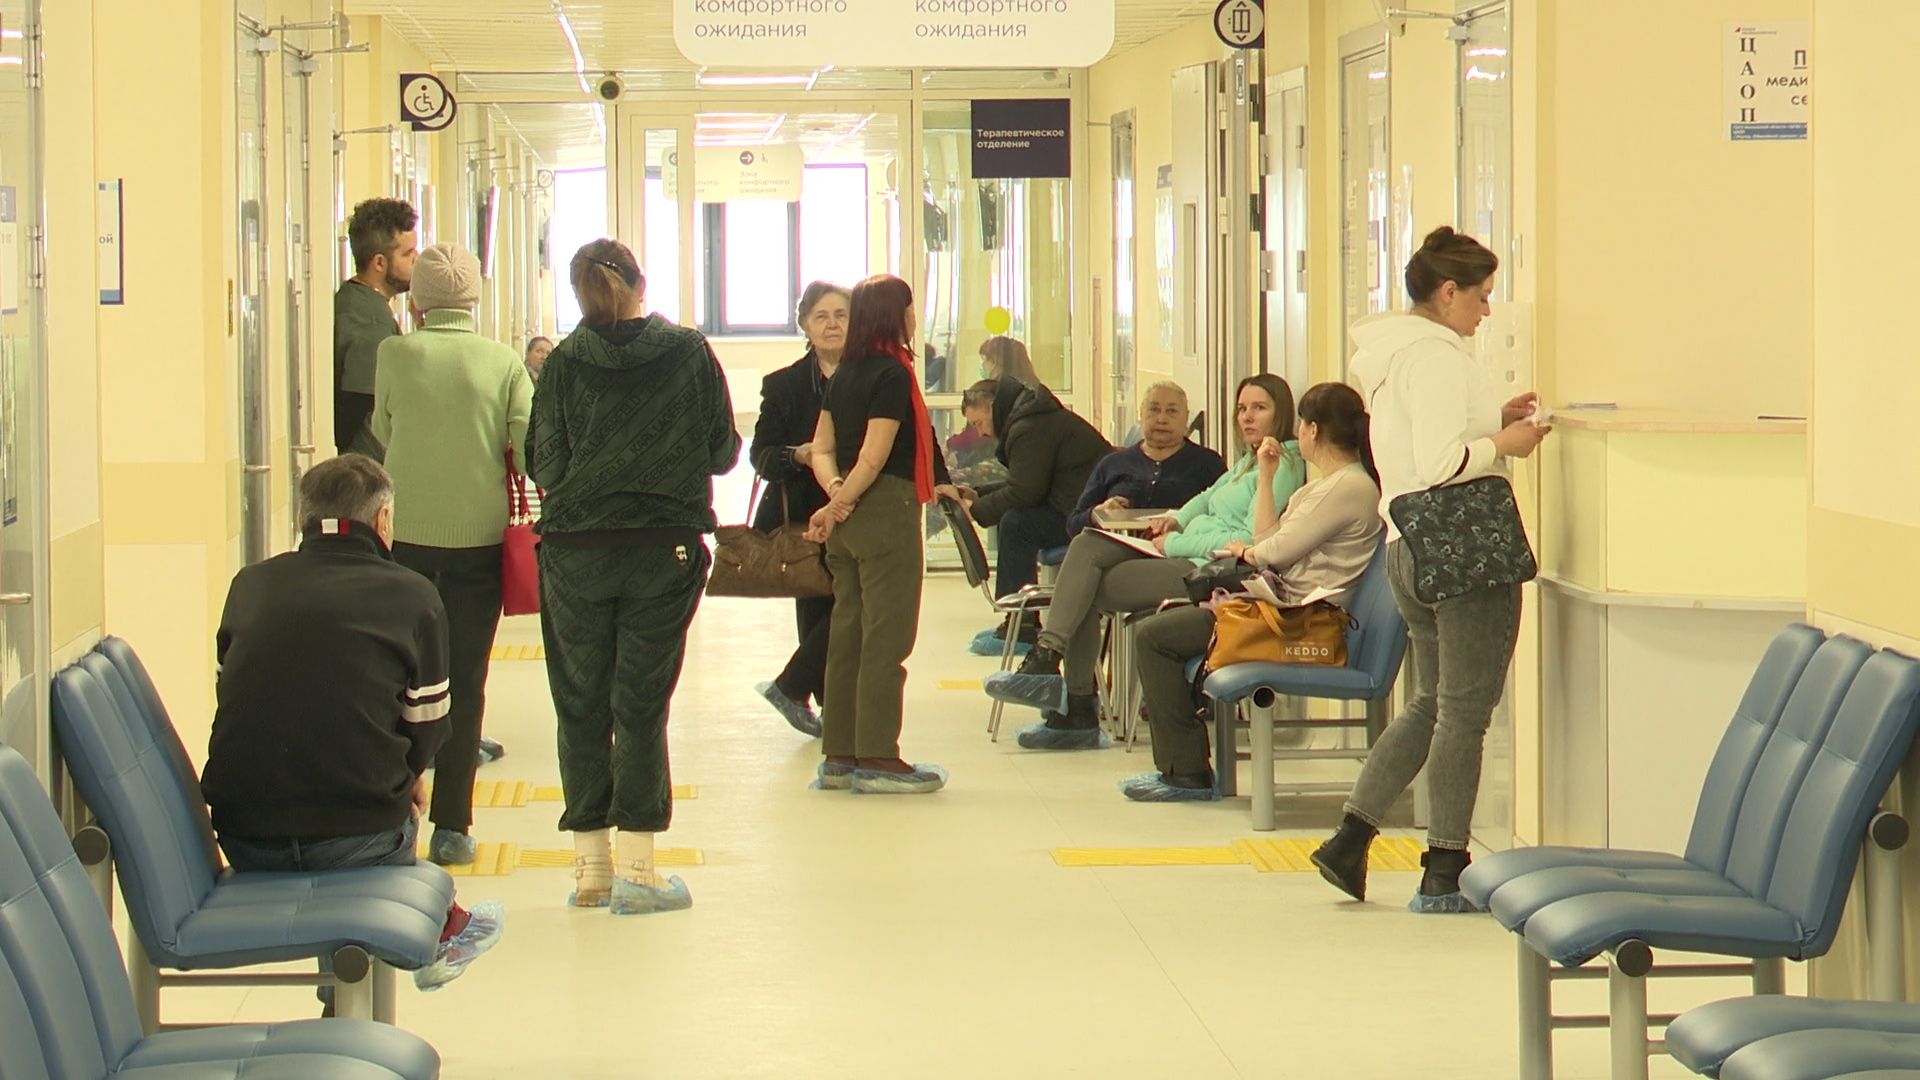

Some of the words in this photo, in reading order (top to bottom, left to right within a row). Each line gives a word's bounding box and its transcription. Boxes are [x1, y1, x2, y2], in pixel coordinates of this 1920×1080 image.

[695, 0, 847, 15] комфортного
[915, 0, 1067, 15] комфортного
[695, 24, 807, 40] ожидания
[915, 24, 1027, 40] ожидания
[976, 129, 1065, 139] Терапевтическое
[976, 141, 1030, 150] отделение
[1285, 646, 1329, 656] KEDDO
